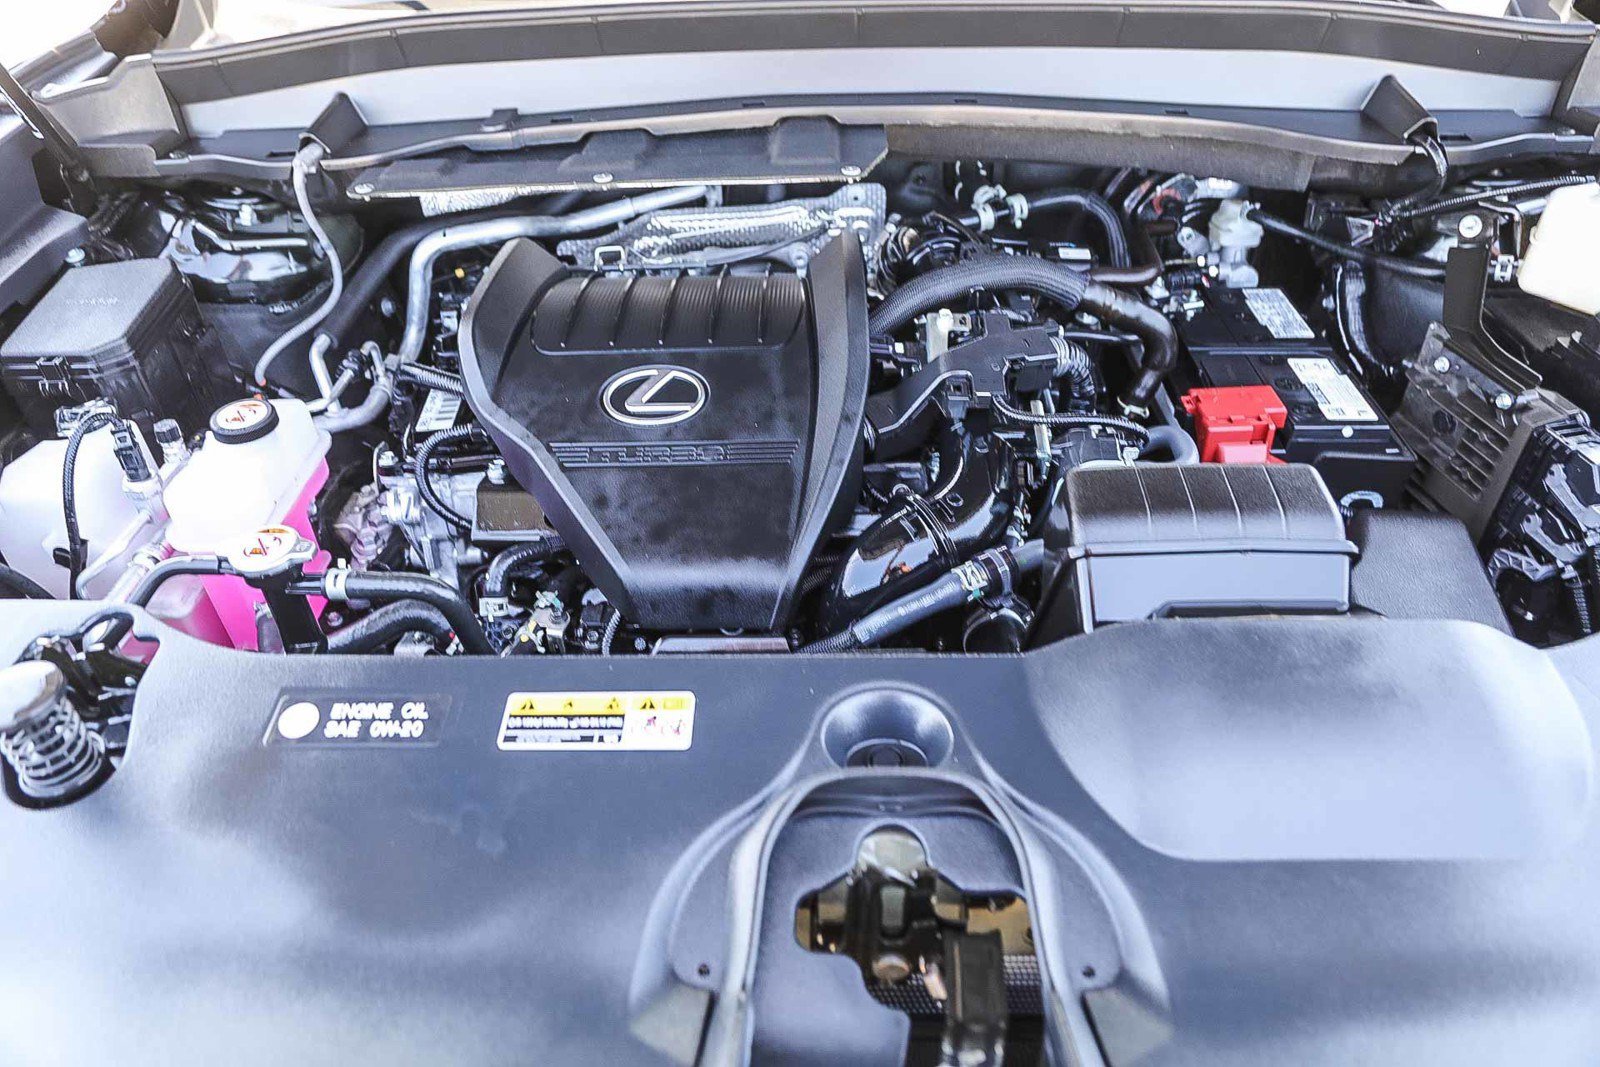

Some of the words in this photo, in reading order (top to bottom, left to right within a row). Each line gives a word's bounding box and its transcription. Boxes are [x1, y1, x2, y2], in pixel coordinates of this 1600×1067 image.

[591, 445, 724, 463] TURBO
[330, 702, 394, 720] ENGINE
[401, 702, 429, 720] OIL
[324, 720, 362, 738] SAE
